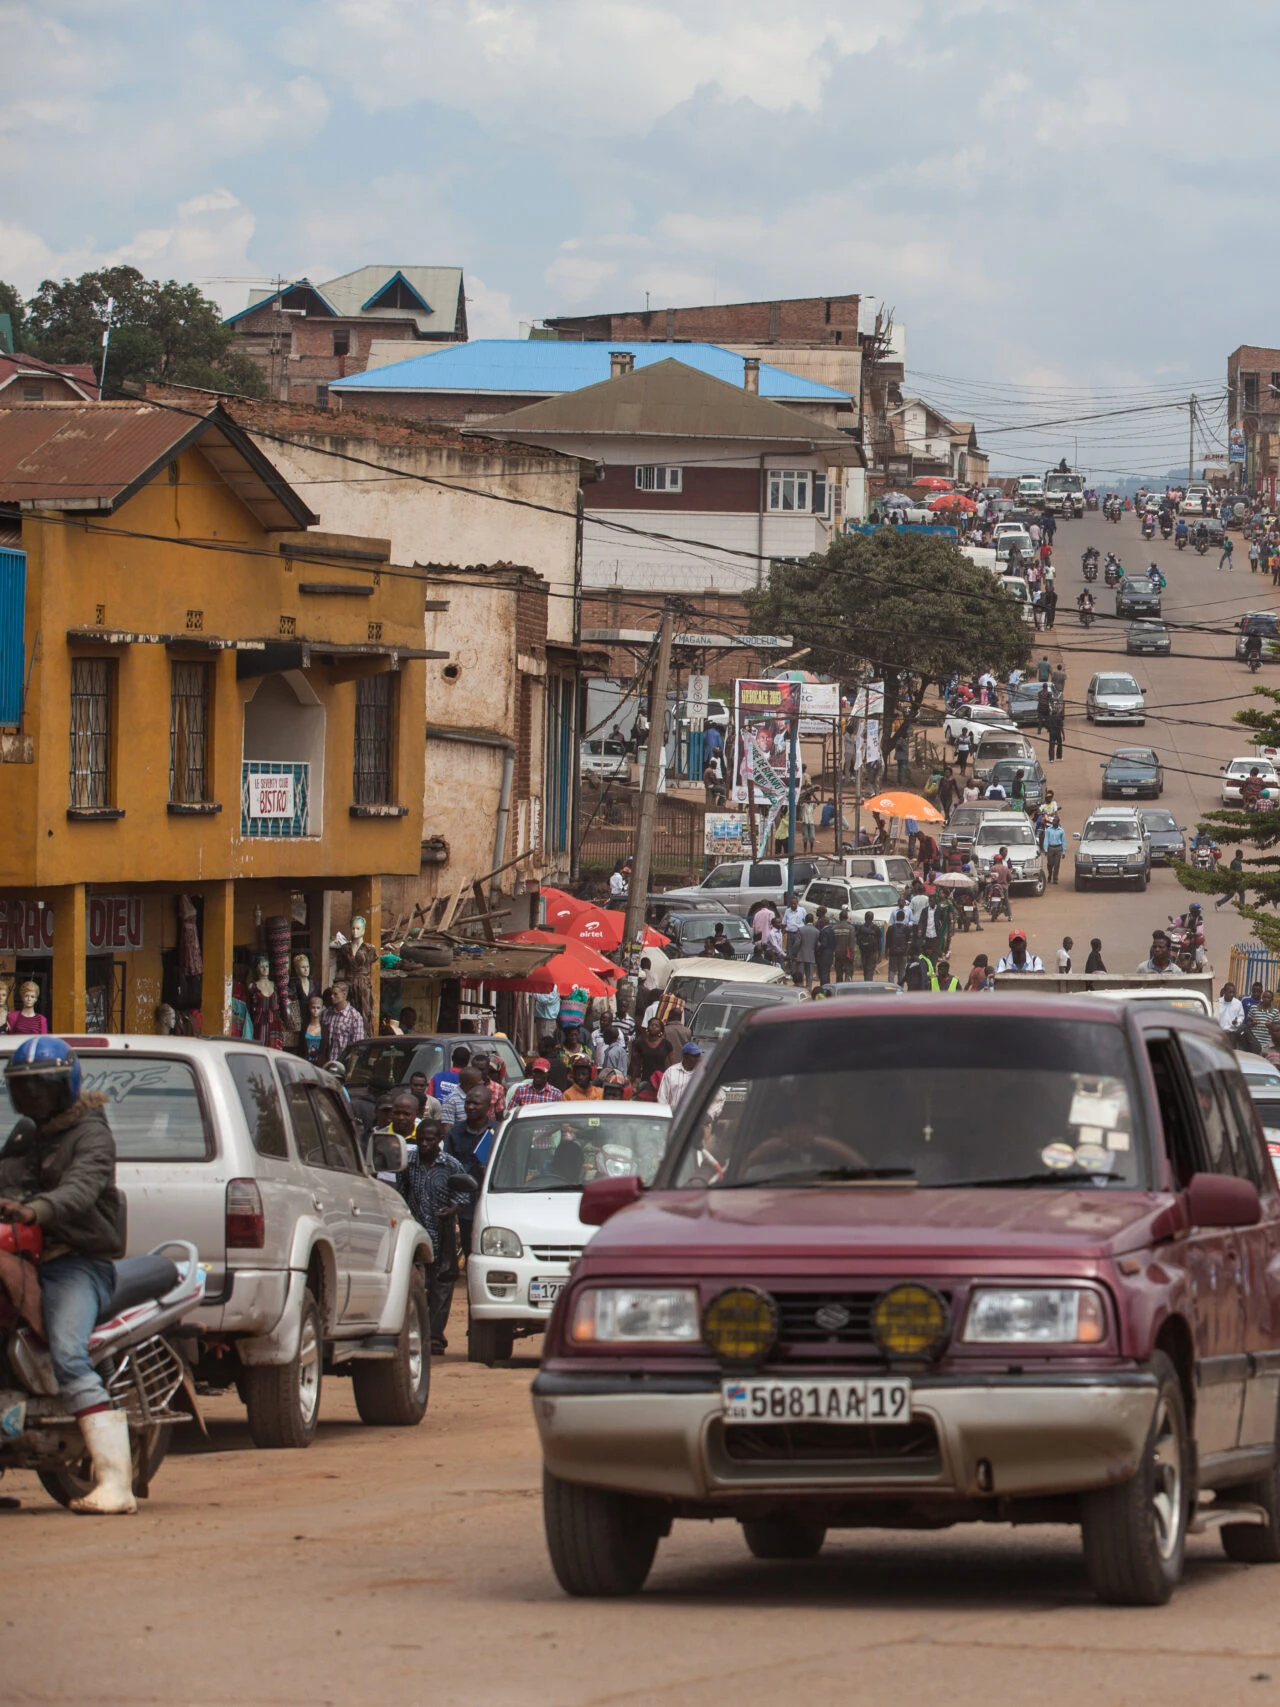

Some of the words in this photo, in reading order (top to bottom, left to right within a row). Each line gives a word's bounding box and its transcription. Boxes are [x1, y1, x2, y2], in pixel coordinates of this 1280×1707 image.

[678, 635, 712, 645] MAGANA
[730, 635, 778, 645] PETROLEUM
[259, 790, 287, 814] BISTRO
[89, 899, 140, 947] DIEU
[870, 1386, 906, 1417] 19
